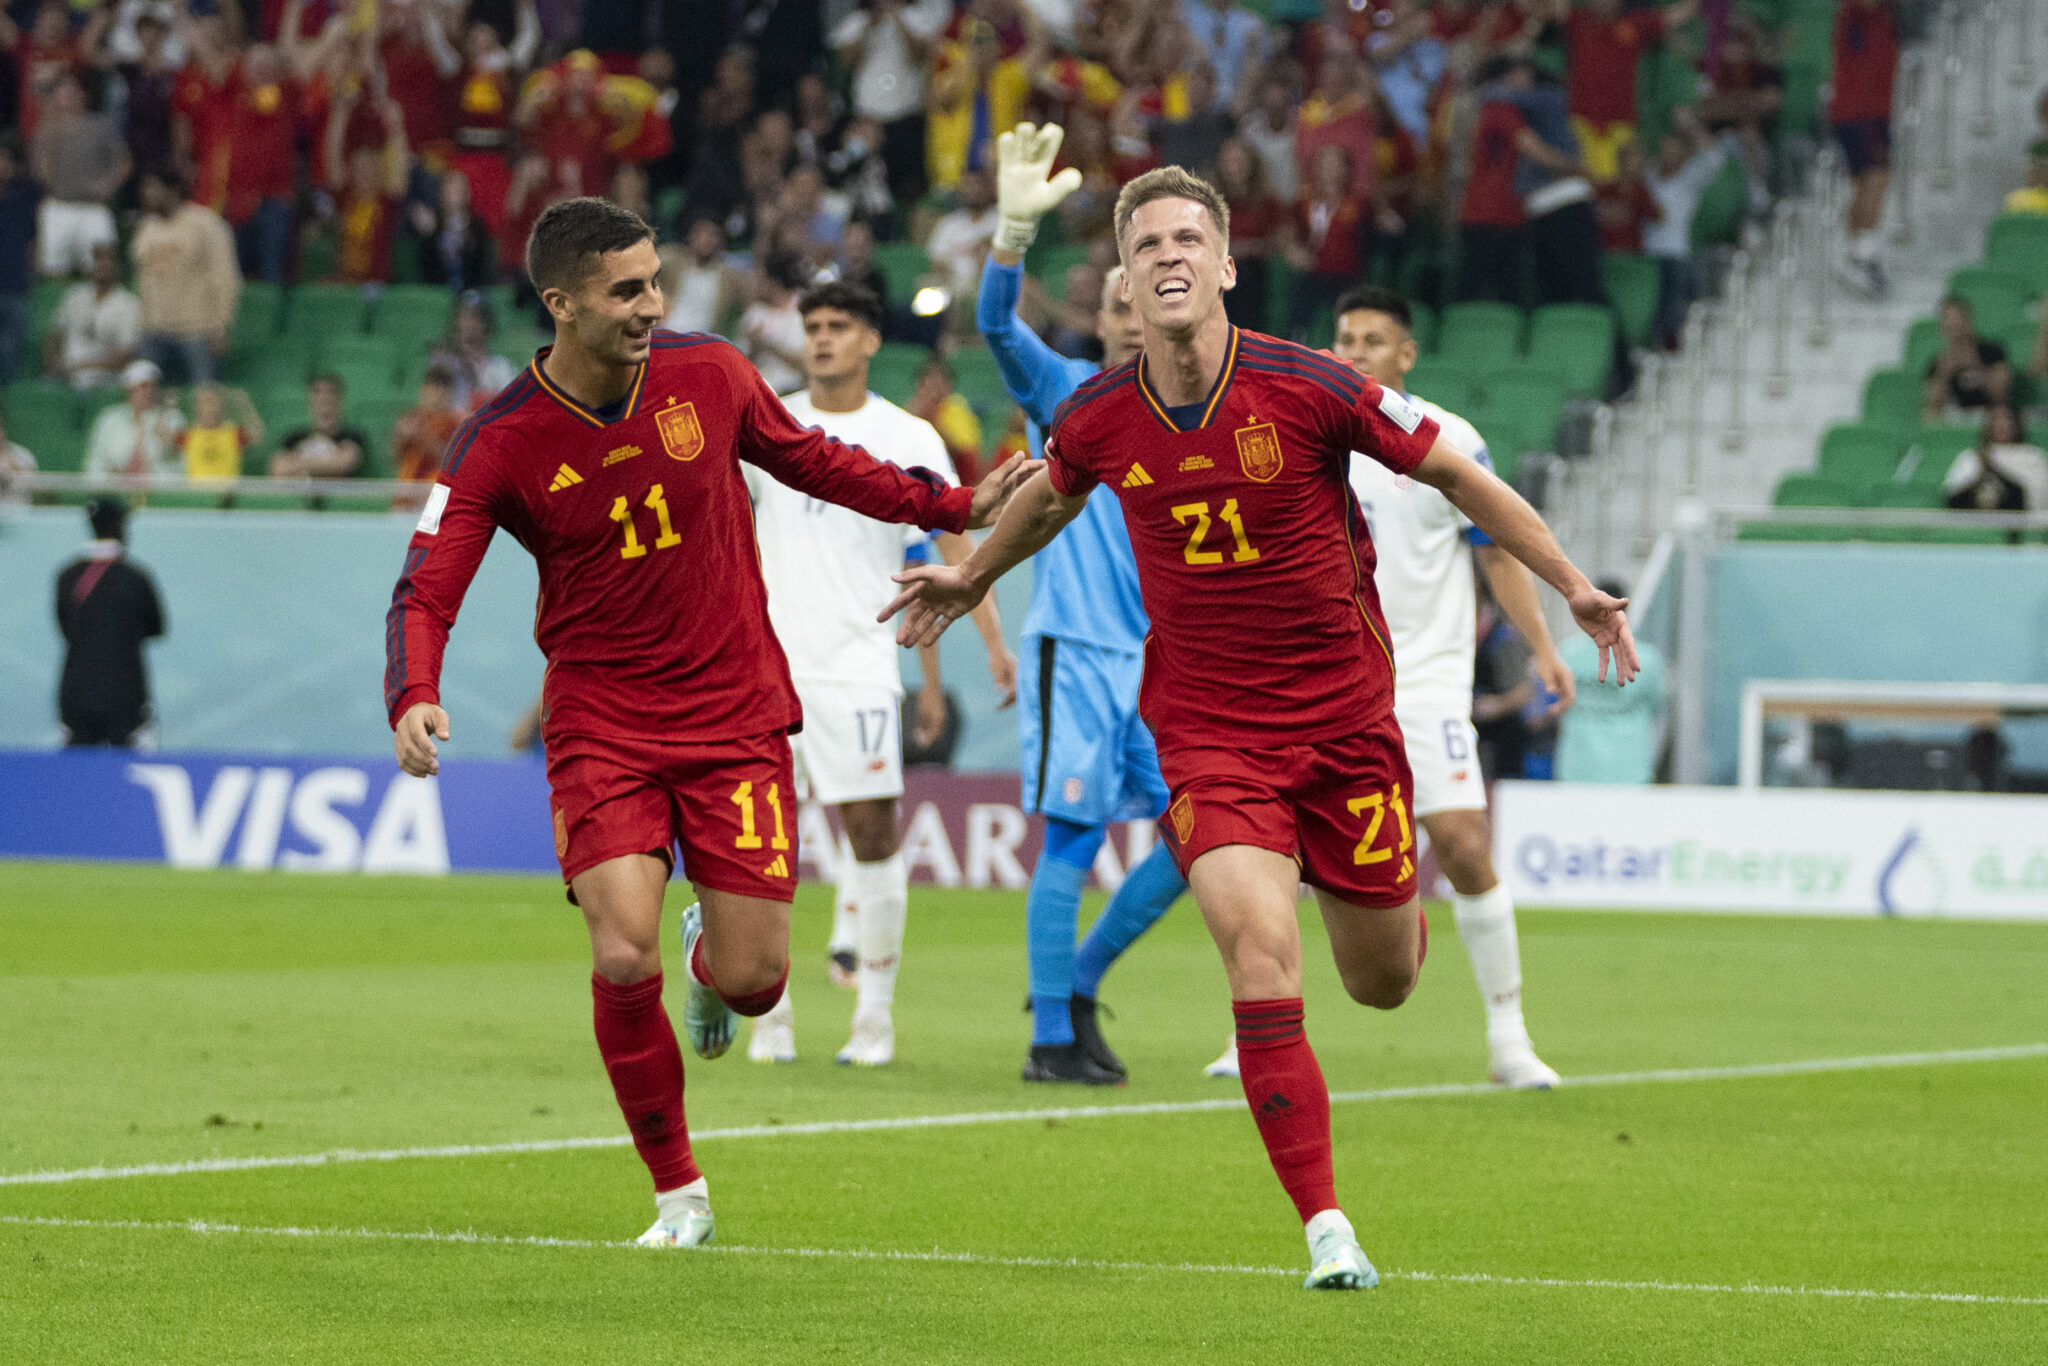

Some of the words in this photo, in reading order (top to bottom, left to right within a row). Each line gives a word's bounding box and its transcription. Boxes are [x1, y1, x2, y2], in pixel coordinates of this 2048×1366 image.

[609, 484, 682, 559] 11
[1171, 498, 1260, 565] 21
[855, 708, 888, 753] 17
[1443, 719, 1468, 760] 6
[127, 763, 450, 872] VISA
[730, 781, 789, 849] 11
[1347, 783, 1412, 865] 21
